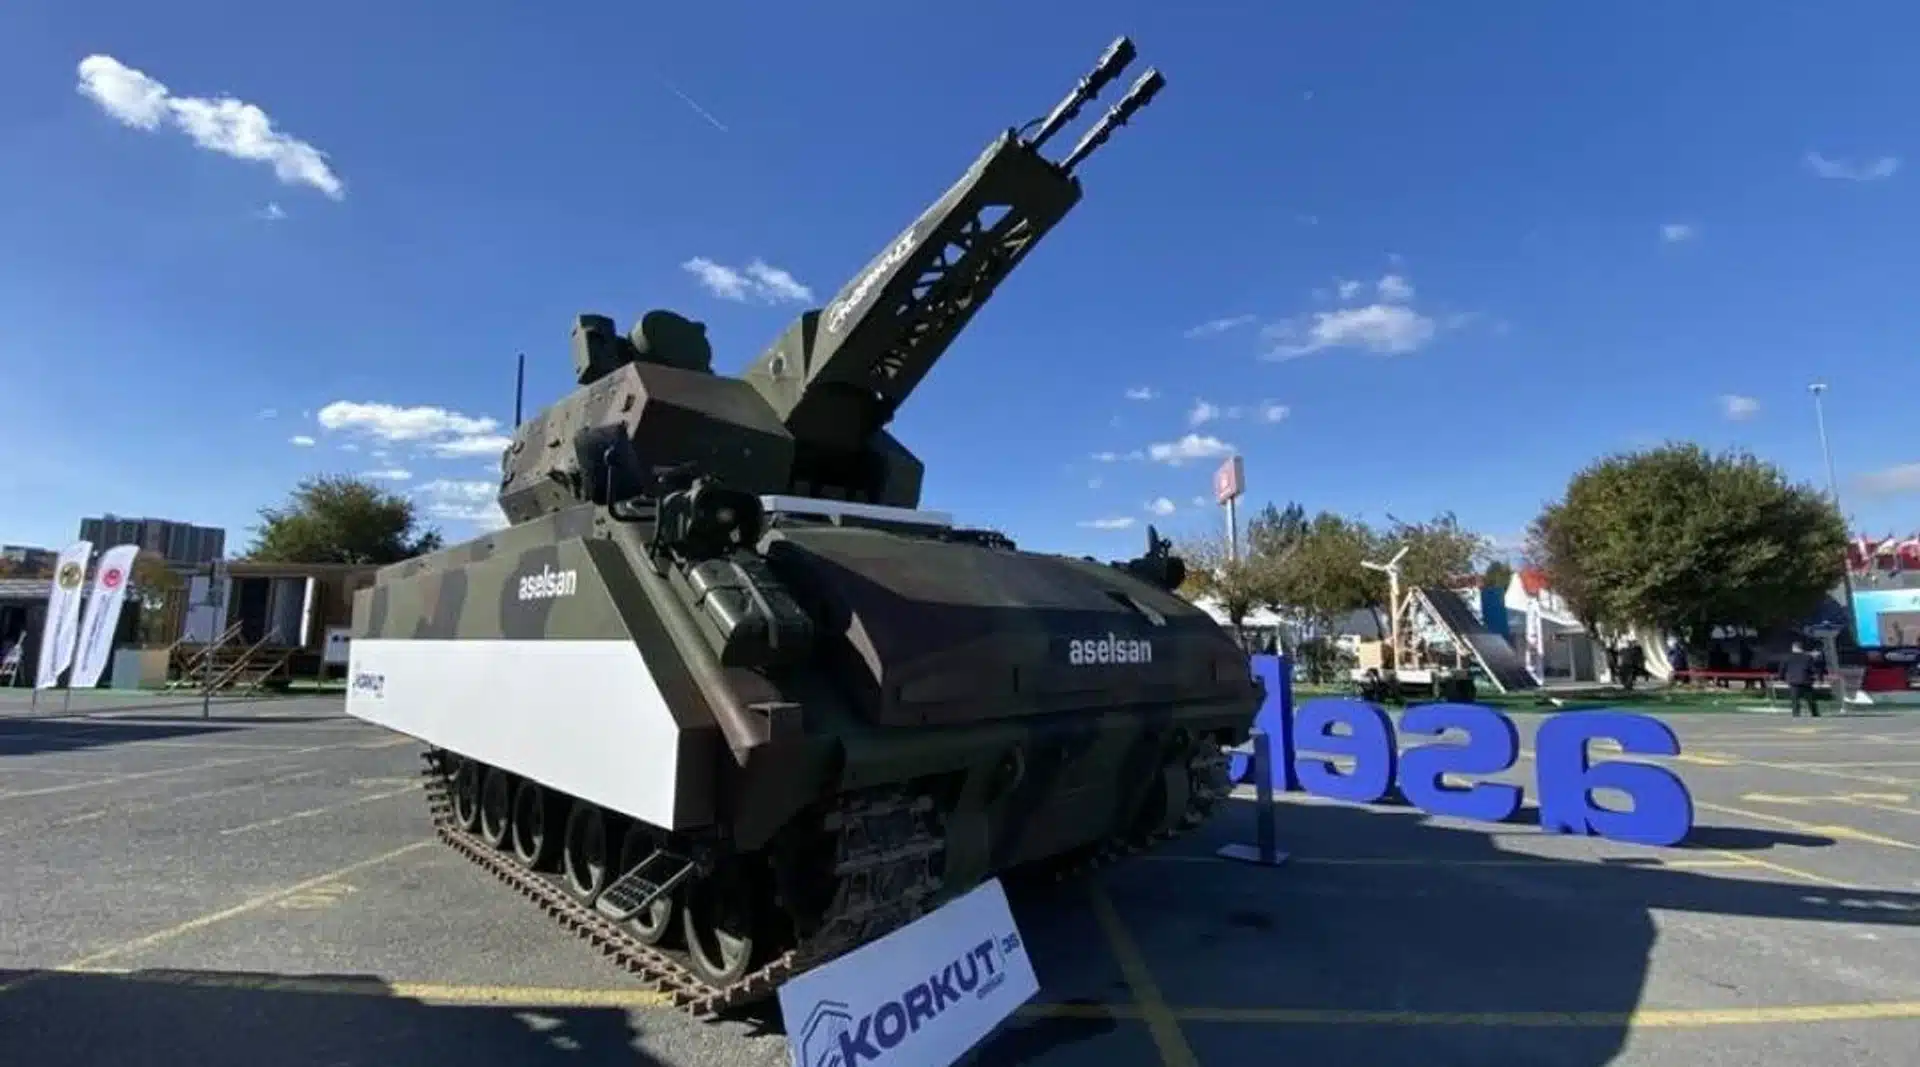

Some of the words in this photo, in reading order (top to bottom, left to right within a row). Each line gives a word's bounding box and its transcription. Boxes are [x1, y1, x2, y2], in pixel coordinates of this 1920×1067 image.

[519, 564, 577, 600] aselsan
[1069, 631, 1153, 664] aselsan
[838, 938, 995, 1067] KORKUT
